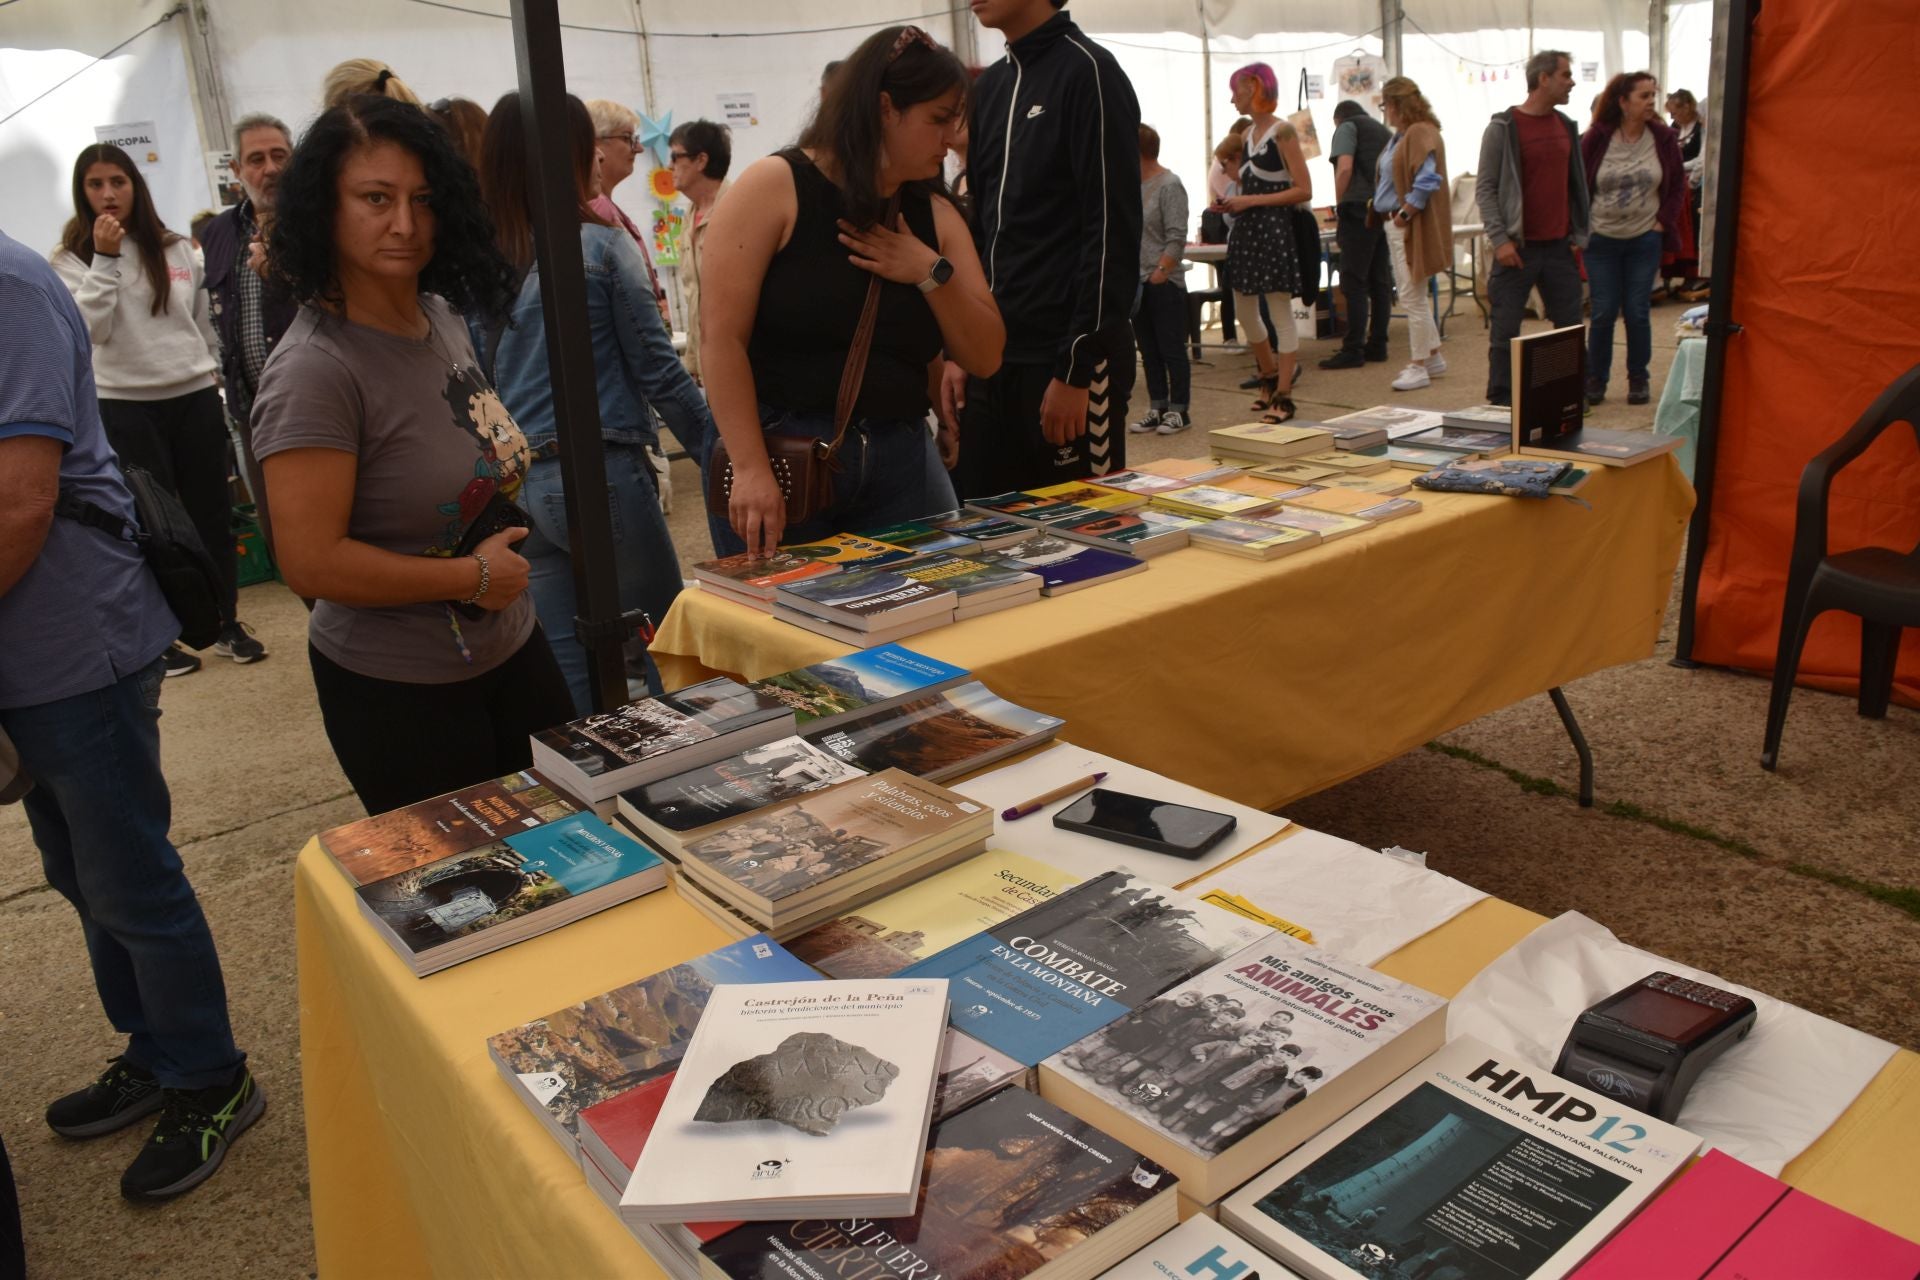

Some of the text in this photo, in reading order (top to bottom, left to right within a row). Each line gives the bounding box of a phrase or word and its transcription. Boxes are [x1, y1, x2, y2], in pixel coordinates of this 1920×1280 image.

[470, 799, 507, 826] PALENTINA
[872, 781, 921, 807] Palabras,
[924, 805, 953, 818] ecos
[874, 796, 929, 820] silencios
[994, 869, 1058, 898] Secundar
[1001, 886, 1017, 895] de
[1017, 891, 1044, 907] Cas
[990, 945, 1103, 1007] EN LA MONTAÑA
[1009, 936, 1127, 997] COMBATE
[744, 993, 904, 1008] Castrejón de la Peña
[1234, 963, 1386, 1031] ANIMALES
[1260, 955, 1396, 1019] Mis amigos y otros
[740, 1007, 777, 1016] historia
[787, 1004, 839, 1013] tradiciones
[1224, 973, 1365, 1040] Andanzas de un naturalista de pueblo
[1041, 1120, 1064, 1136] MANUEL
[1063, 1133, 1089, 1150] FRANCO
[1087, 1147, 1113, 1164] CRESPO
[1436, 1071, 1644, 1176] COLECCIÓN HISTORIA DE LA MONTAÑA PALENTINA
[767, 1235, 794, 1257] Historias
[768, 1253, 779, 1262] en
[840, 1218, 942, 1280] SI FUER
